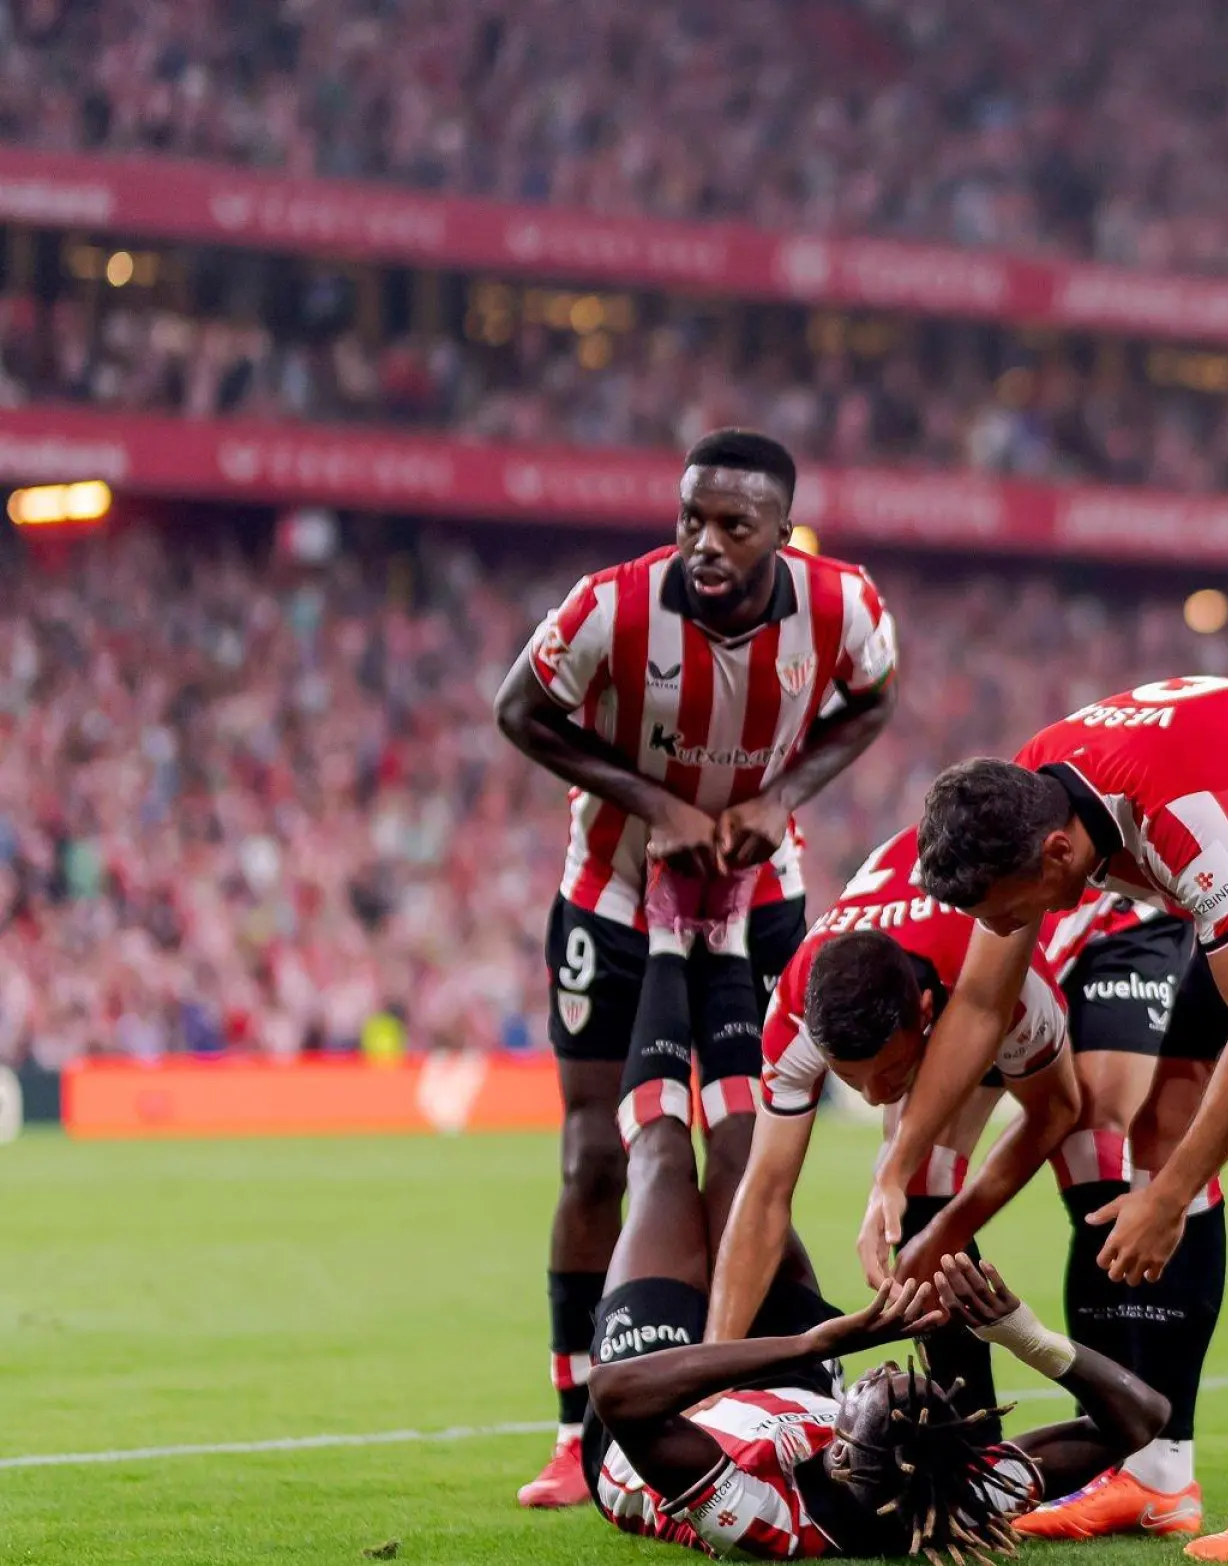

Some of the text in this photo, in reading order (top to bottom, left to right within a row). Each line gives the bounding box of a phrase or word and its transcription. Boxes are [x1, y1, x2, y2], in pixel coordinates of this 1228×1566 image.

[649, 721, 789, 766] Kutxabak
[558, 926, 597, 992] 9
[1083, 972, 1174, 1009] vueling
[600, 1324, 691, 1362] vueling
